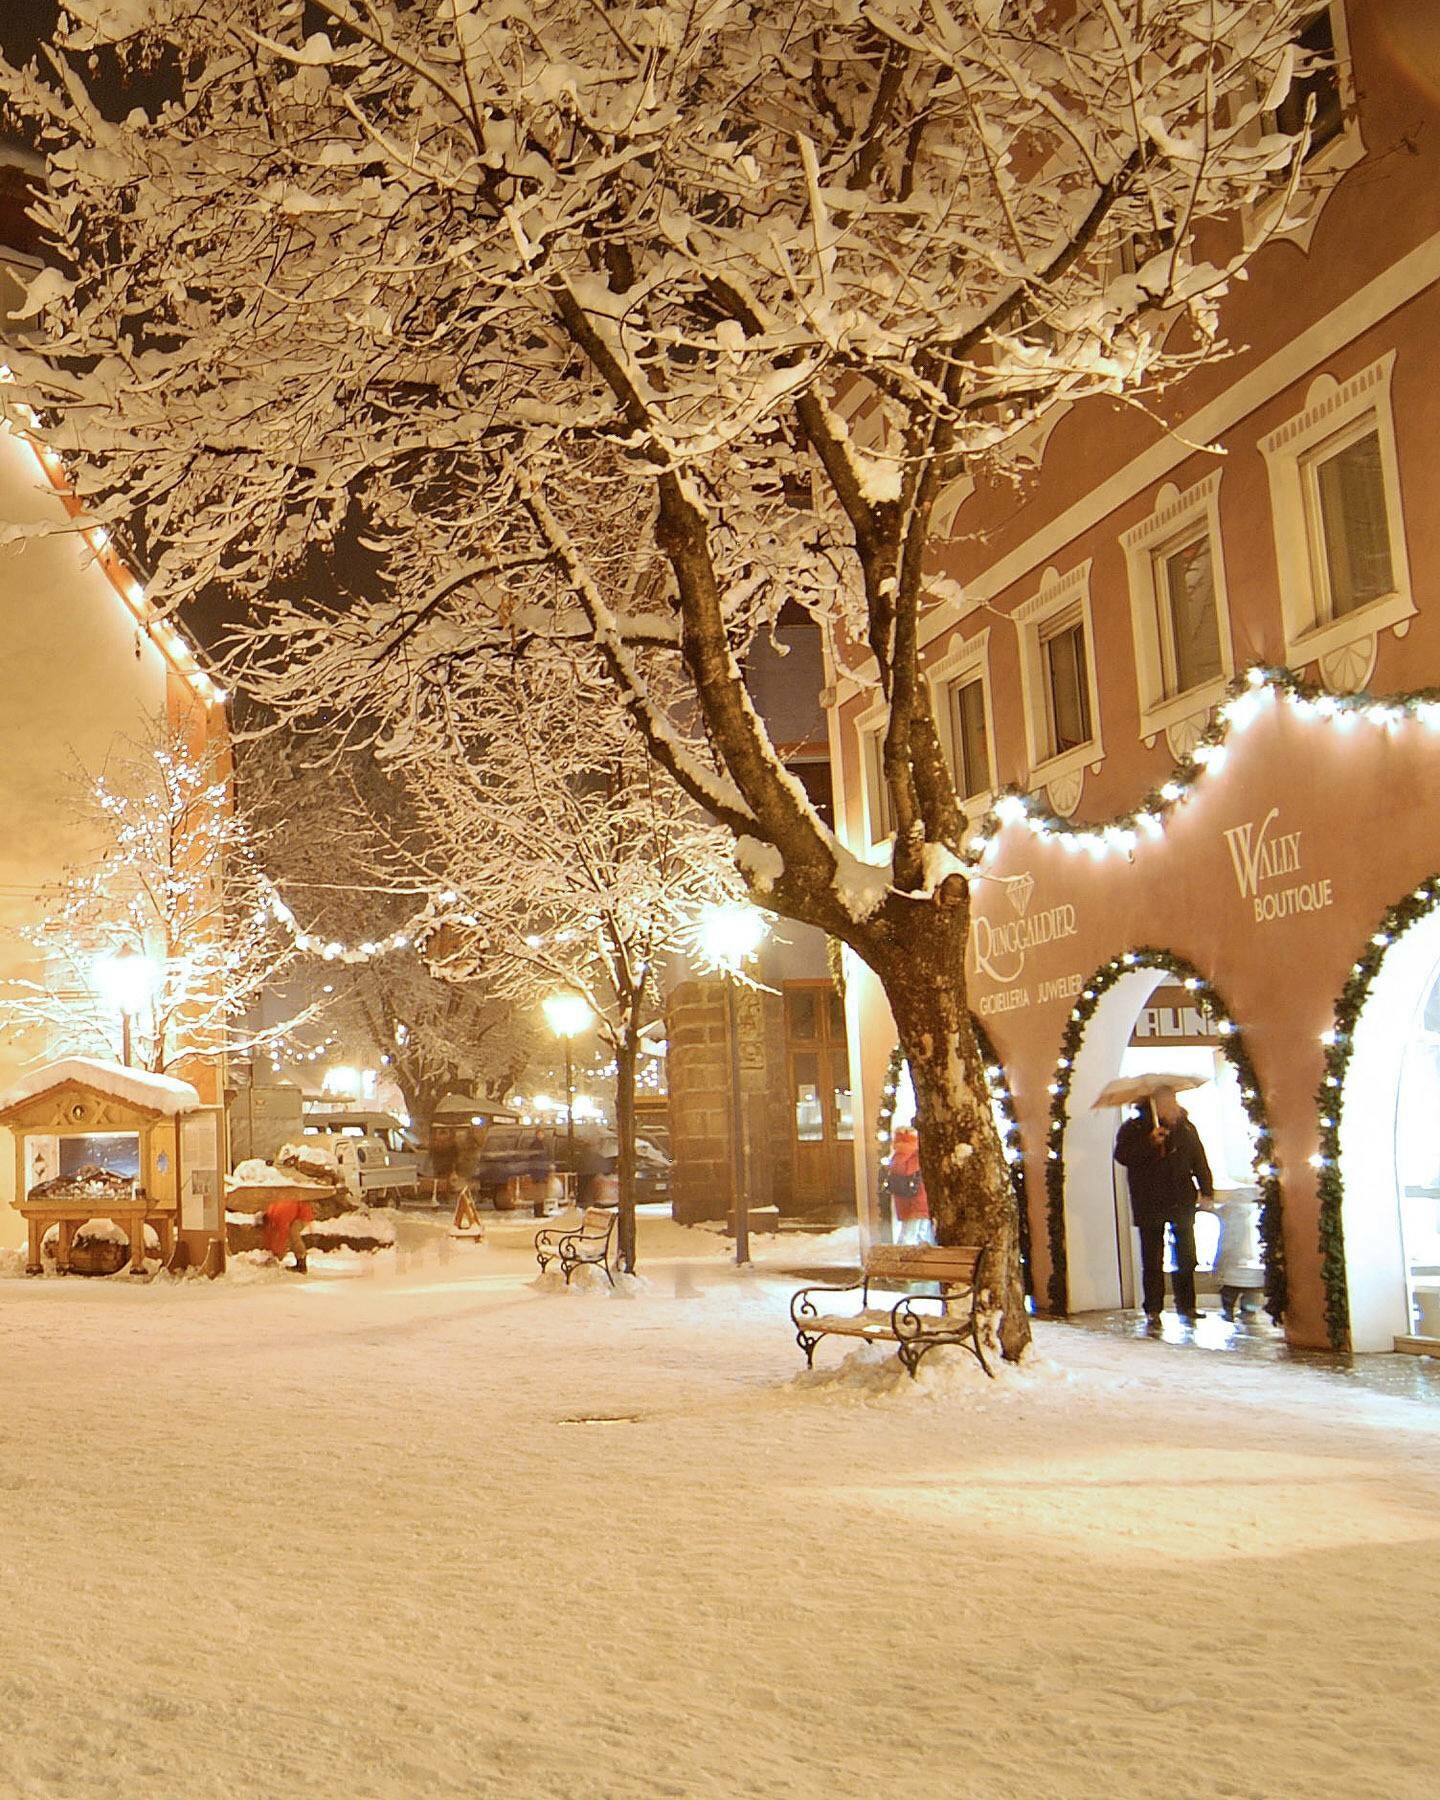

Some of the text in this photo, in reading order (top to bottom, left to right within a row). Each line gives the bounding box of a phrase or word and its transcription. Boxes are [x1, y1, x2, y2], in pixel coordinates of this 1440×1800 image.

[1223, 807, 1302, 898] WALLY
[1254, 879, 1333, 922] BOUTIQUE
[971, 903, 1078, 983] RUNGGALDIER
[980, 973, 1082, 1016] GIOIELLERIA JUWELIER
